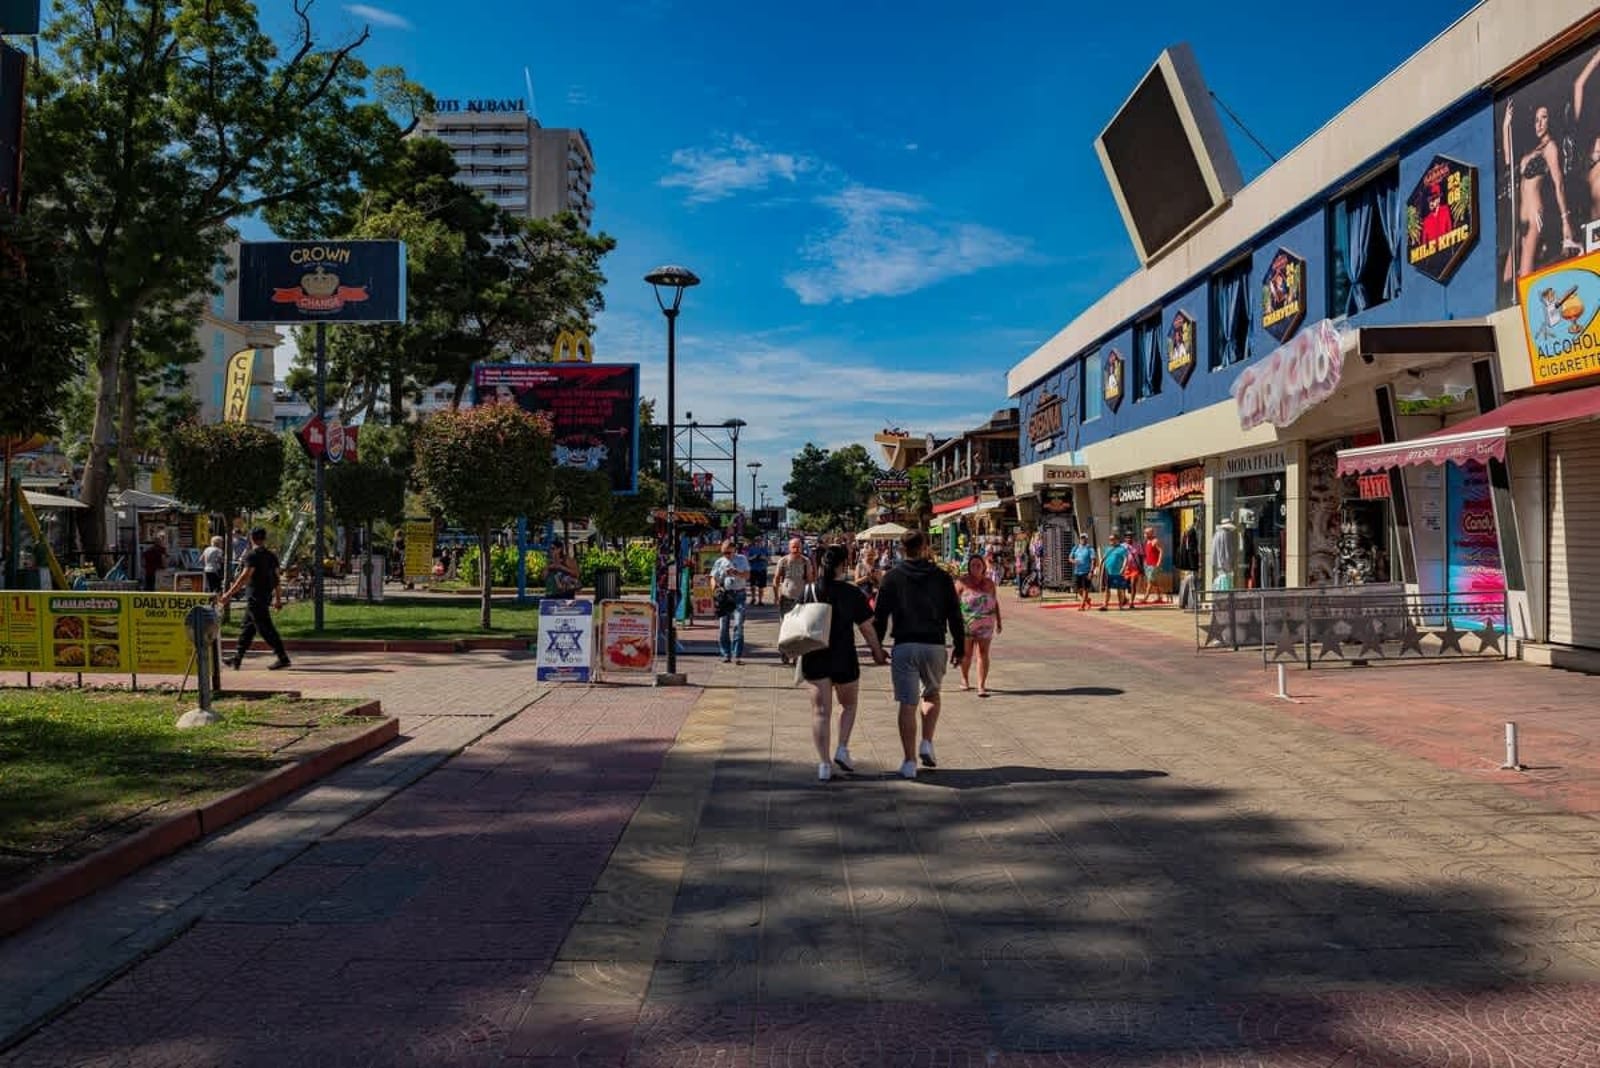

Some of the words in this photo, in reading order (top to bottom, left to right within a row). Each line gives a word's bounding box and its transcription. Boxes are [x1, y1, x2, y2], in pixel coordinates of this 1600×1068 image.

[290, 246, 351, 265] CROWN
[300, 297, 343, 310] CHANGE
[1538, 332, 1600, 359] ALCOHOL
[1540, 354, 1600, 377] CIGARETT
[231, 357, 247, 419] CHAN
[1227, 458, 1251, 472] MODA
[1253, 453, 1285, 470] ITALIA
[1119, 484, 1145, 502] CHANGE
[1464, 513, 1494, 537] Candy
[133, 597, 166, 609] DAILY
